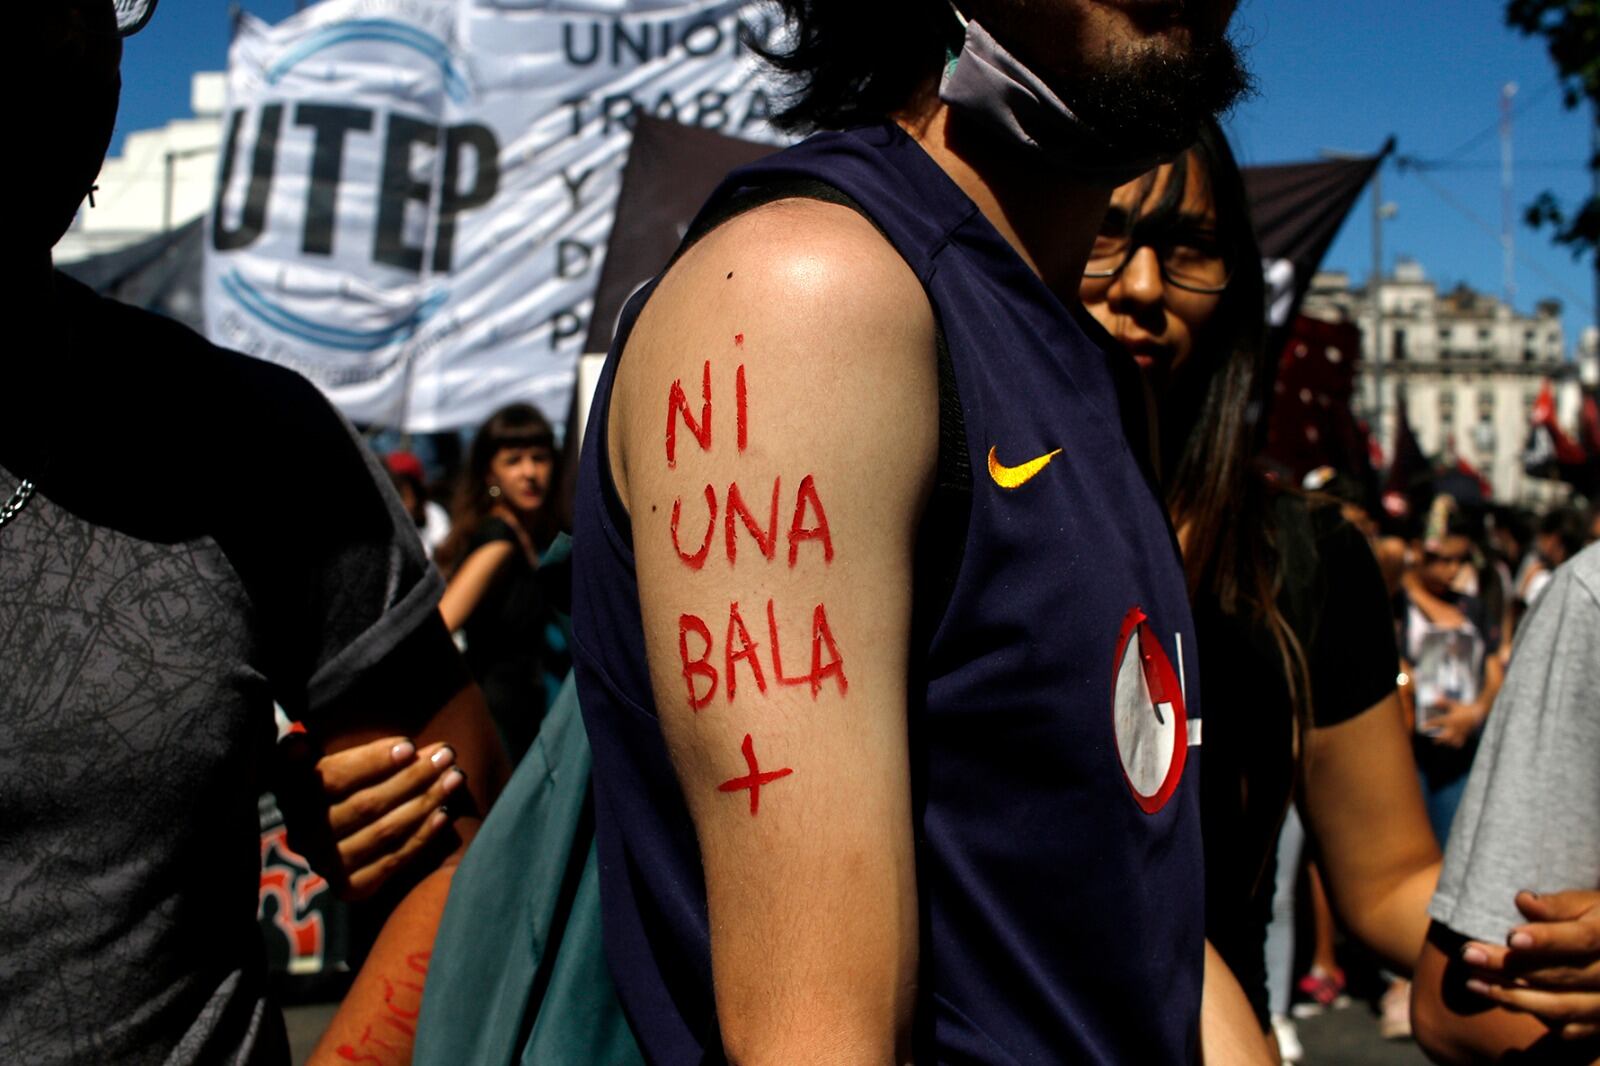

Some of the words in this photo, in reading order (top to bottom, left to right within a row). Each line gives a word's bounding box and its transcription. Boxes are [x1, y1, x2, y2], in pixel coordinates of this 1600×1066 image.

[564, 16, 776, 66] UNION
[213, 103, 500, 273] UTEP
[562, 167, 593, 212] Y
[670, 474, 834, 571] UNA
[679, 598, 848, 713] BALA
